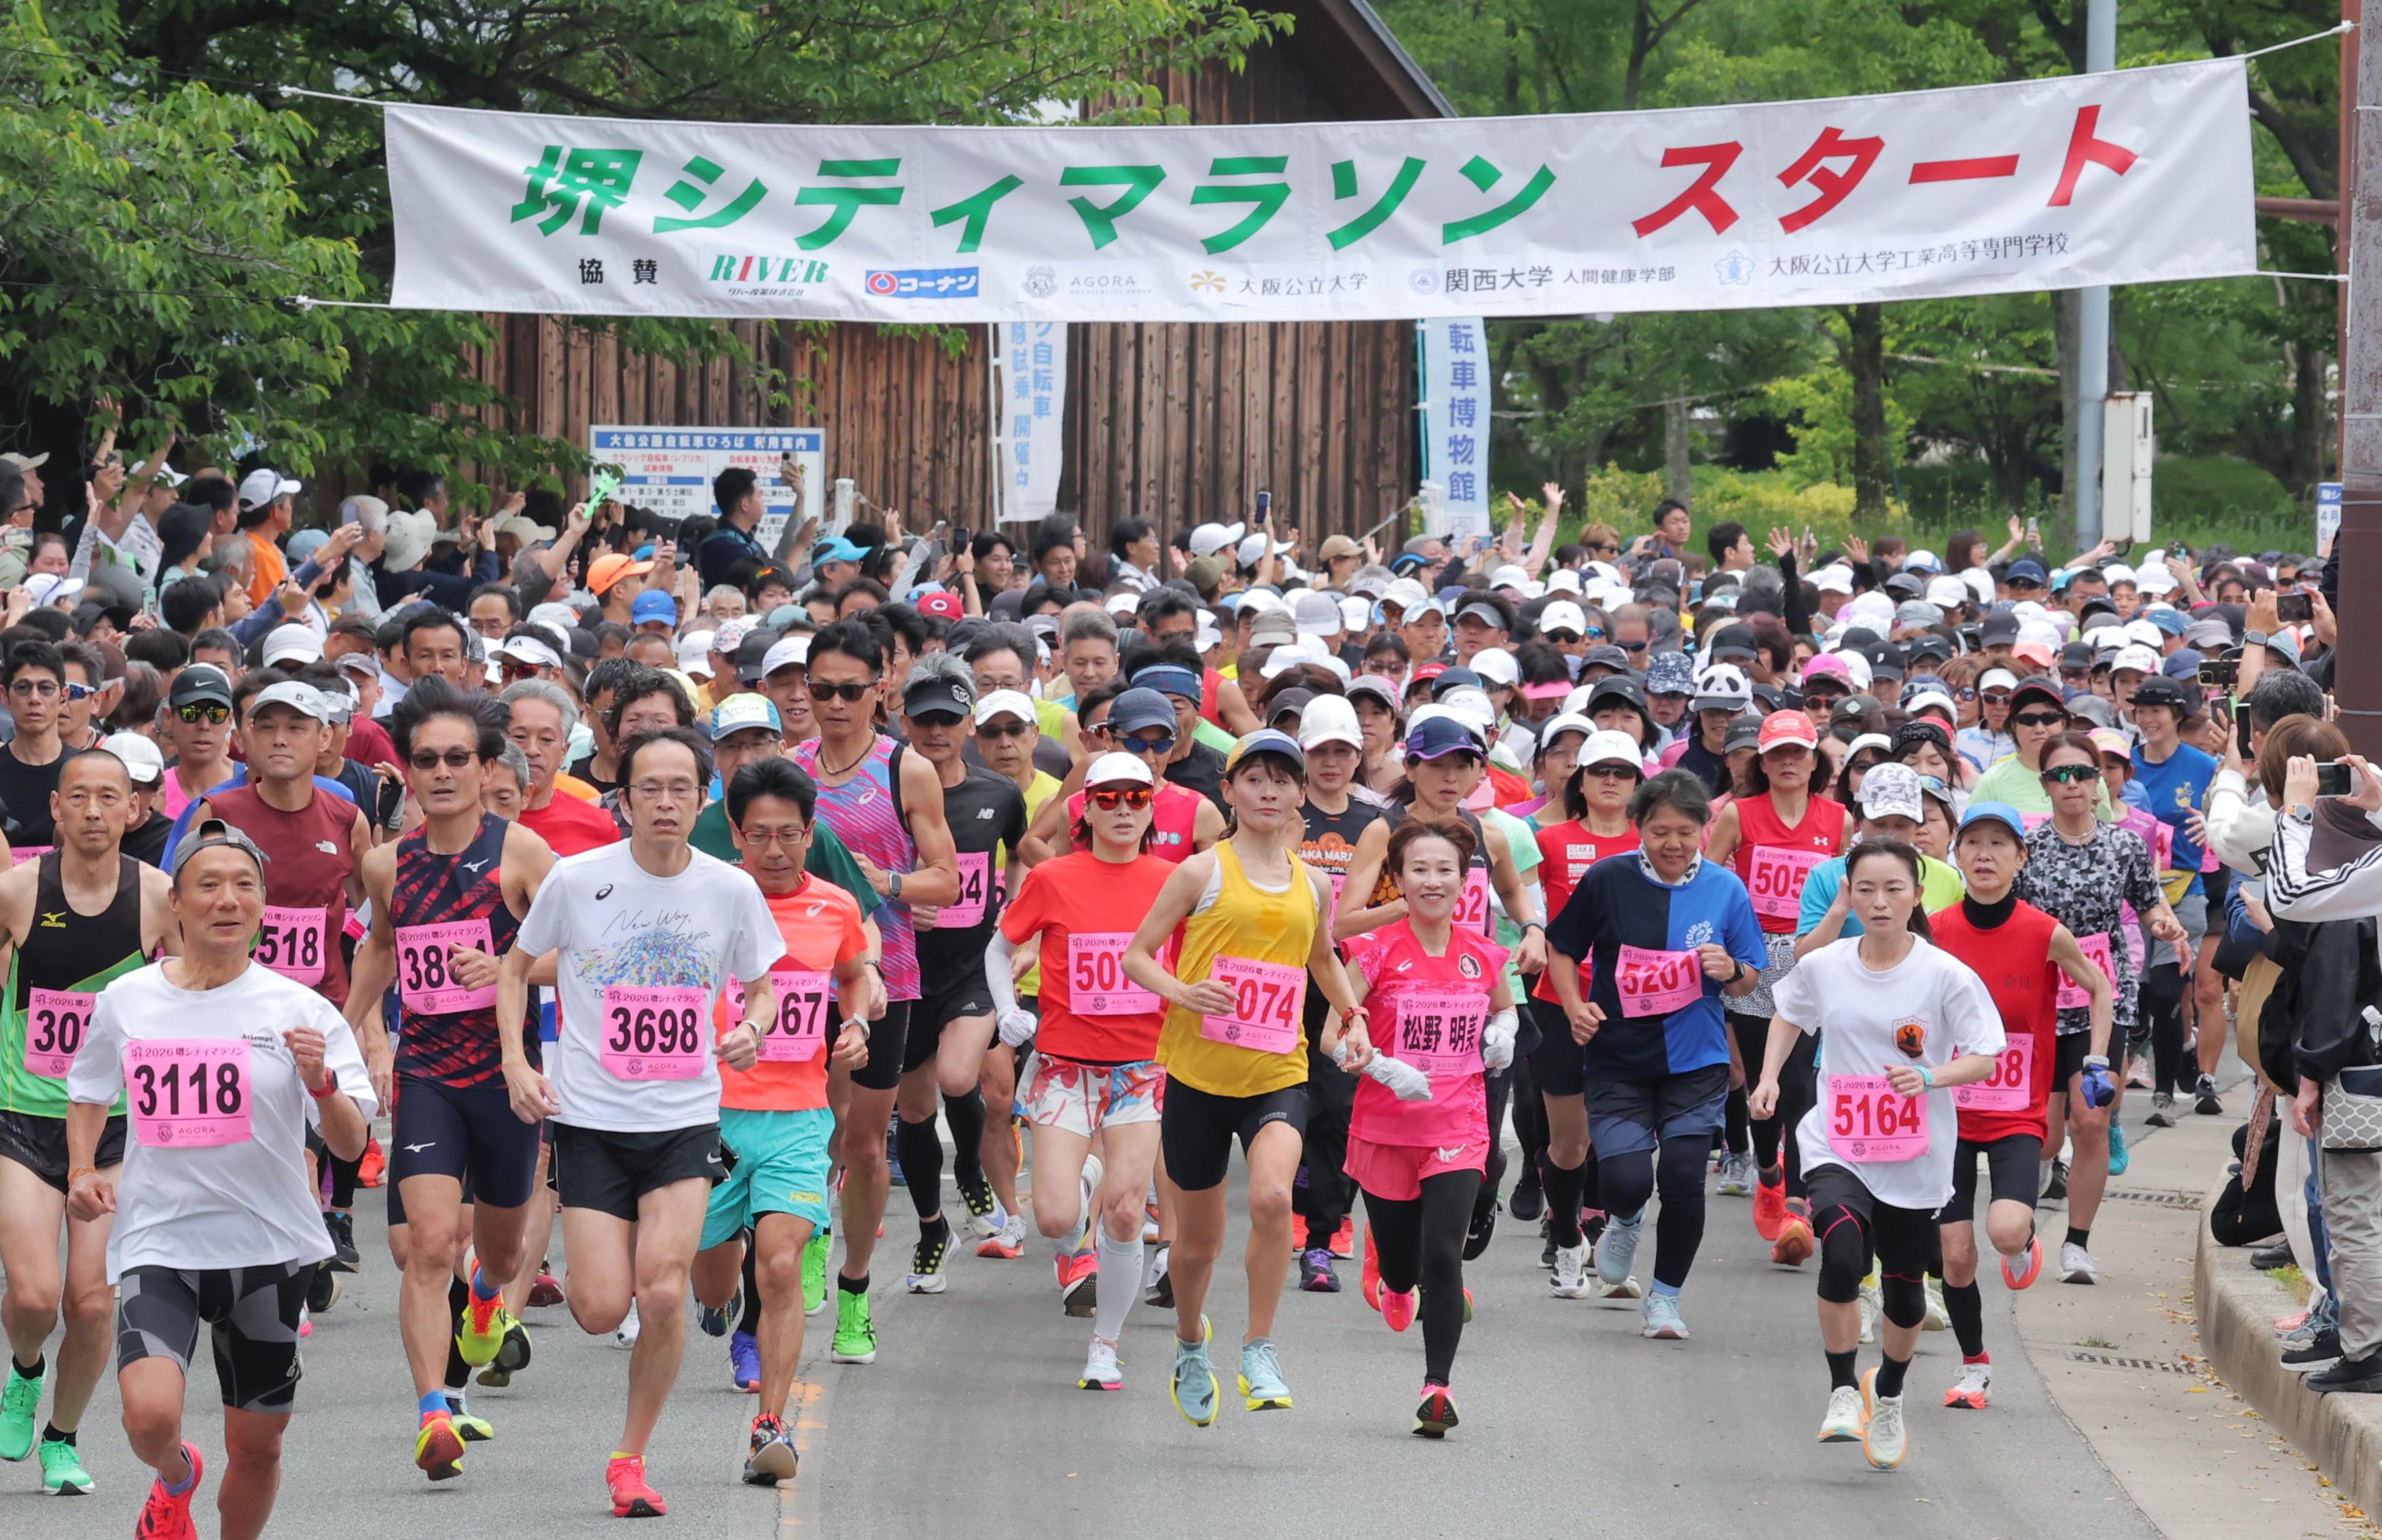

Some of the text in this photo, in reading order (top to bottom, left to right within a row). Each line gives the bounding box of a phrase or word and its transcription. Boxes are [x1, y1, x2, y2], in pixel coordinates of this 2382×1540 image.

[511, 104, 2139, 255] 堺シティマラソン スタート
[1769, 232, 2069, 277] 大阪公立大学工業高等専門学校
[708, 255, 829, 284] RIVER
[899, 275, 977, 291] コーナン
[1070, 276, 1137, 287] AGORA
[1239, 272, 1369, 295] 大阪公立大学
[1445, 265, 1676, 293] 関西大学 人間健康学部
[249, 925, 319, 967] 518
[1622, 955, 1696, 995] 5201
[75, 999, 94, 1007] 堺シ
[440, 994, 471, 1004] AGORA
[624, 994, 649, 1002] 2026
[34, 1009, 92, 1055] 30
[609, 1006, 698, 1055] 3698
[1246, 1031, 1272, 1040] AGORA
[1403, 1014, 1442, 1053] 松野
[145, 1046, 245, 1058] 2026 堺シティマラソン
[134, 1063, 242, 1116] 3118
[1835, 1094, 1920, 1136] 5164
